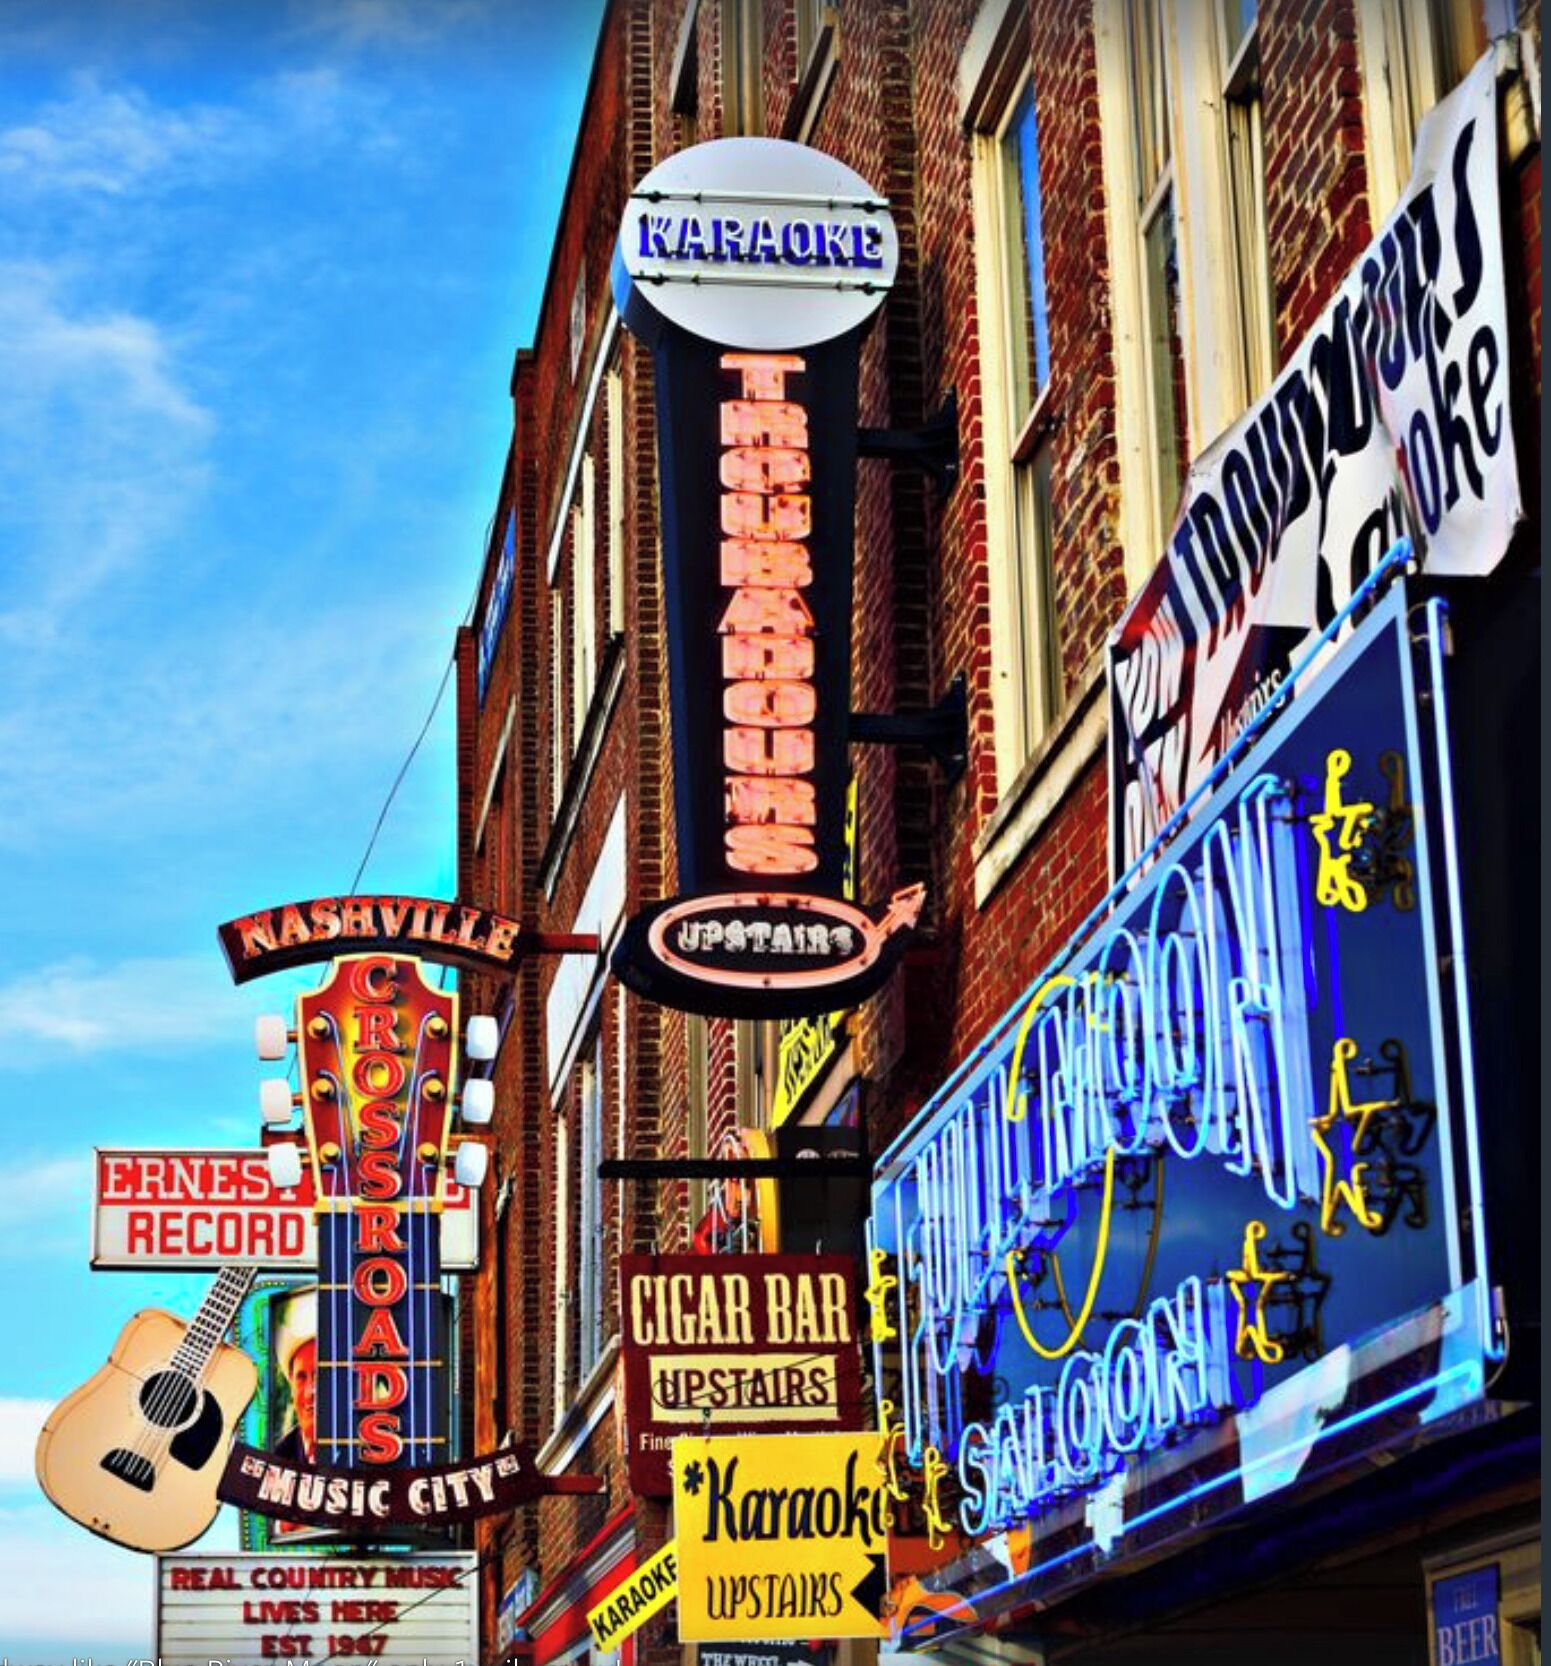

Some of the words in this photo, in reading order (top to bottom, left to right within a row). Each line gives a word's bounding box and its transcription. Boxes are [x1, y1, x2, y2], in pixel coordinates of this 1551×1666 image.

[638, 212, 885, 269] KARAOKE
[718, 354, 820, 875] TROUBADOURS
[233, 896, 521, 961] NASHVILLE
[678, 920, 854, 956] UPSTAIRS
[127, 1212, 304, 1256] RECORD
[350, 956, 408, 1464] CROSSROADS
[631, 1274, 754, 1346] CIGAR
[764, 1273, 851, 1344] BAR
[659, 1367, 829, 1406] UPSTAIRS
[960, 1275, 1208, 1536] SALOON
[170, 1567, 241, 1591] REAL
[250, 1567, 378, 1589] COUNTRY
[385, 1567, 464, 1588] MUSIC
[706, 1572, 842, 1620] UPSTAIRS
[243, 1600, 319, 1624] LIVES
[331, 1600, 399, 1623] HERE
[1437, 1614, 1498, 1666] BEER
